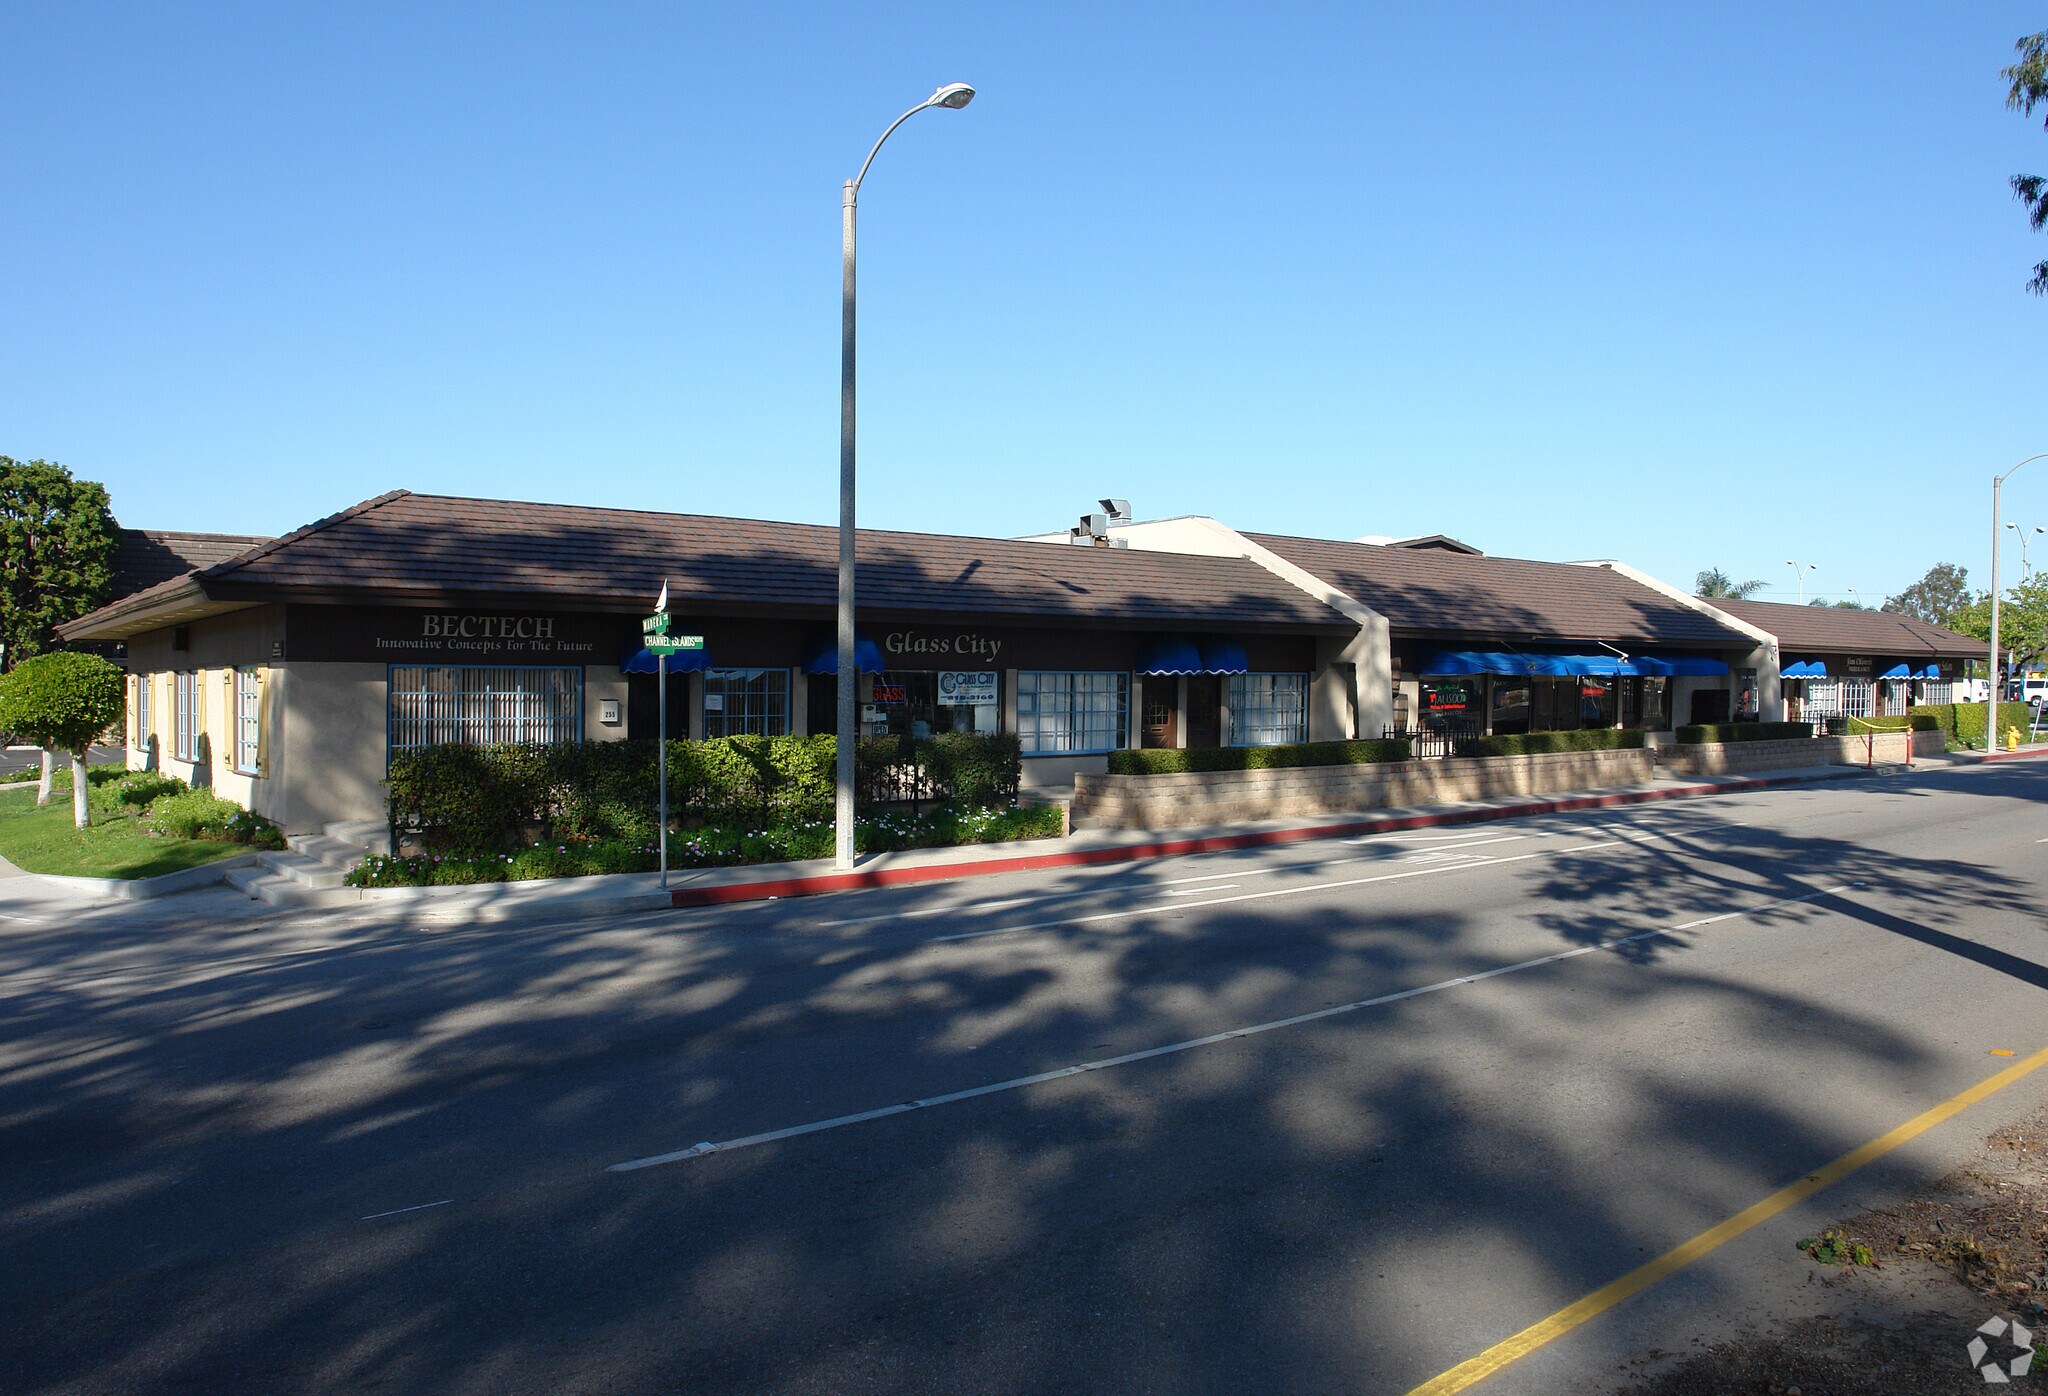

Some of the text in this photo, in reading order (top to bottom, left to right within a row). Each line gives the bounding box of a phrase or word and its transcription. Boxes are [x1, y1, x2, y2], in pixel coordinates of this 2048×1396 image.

[421, 614, 556, 638] BECTECH
[375, 637, 594, 654] Innovative Concepts For The Future
[645, 636, 671, 647] CHANNEL
[671, 636, 695, 647] ISLANDS
[885, 631, 1002, 662] Glass City
[956, 672, 995, 685] GLASS CITY
